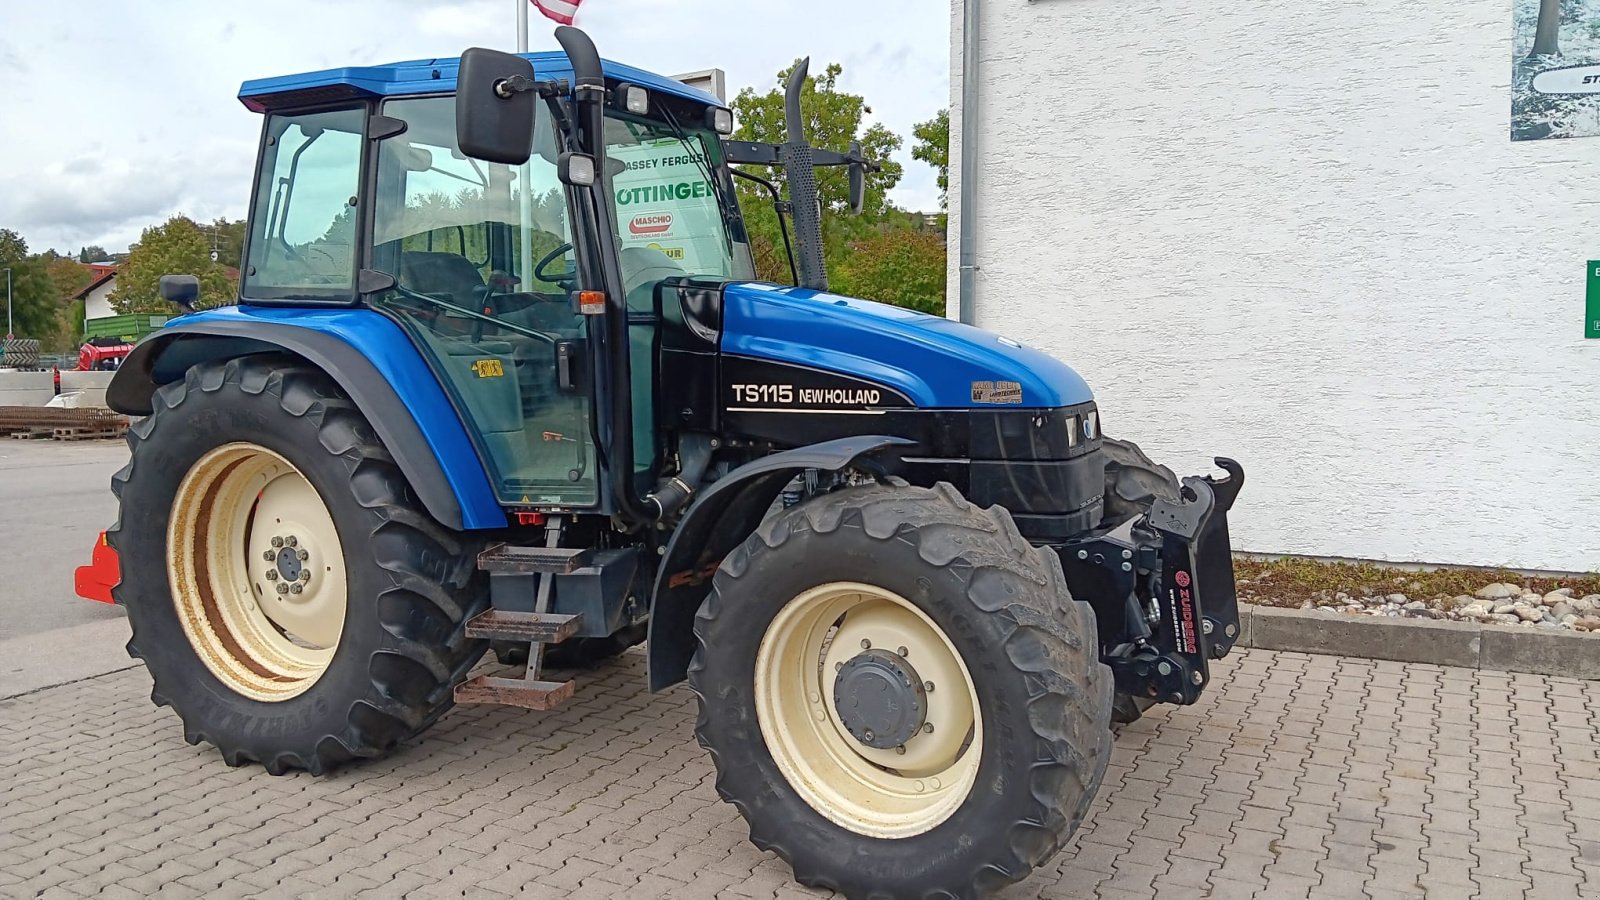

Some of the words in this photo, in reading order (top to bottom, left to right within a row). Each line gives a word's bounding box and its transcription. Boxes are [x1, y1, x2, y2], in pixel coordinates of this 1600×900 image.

[1582, 75, 1600, 84] ST
[625, 158, 658, 171] ASSEY
[662, 153, 704, 167] FERGUS
[616, 180, 712, 205] ÖTTINGE
[635, 215, 671, 225] MASCHIO
[731, 384, 793, 403] TS115
[1180, 588, 1197, 654] ZUIDBERG
